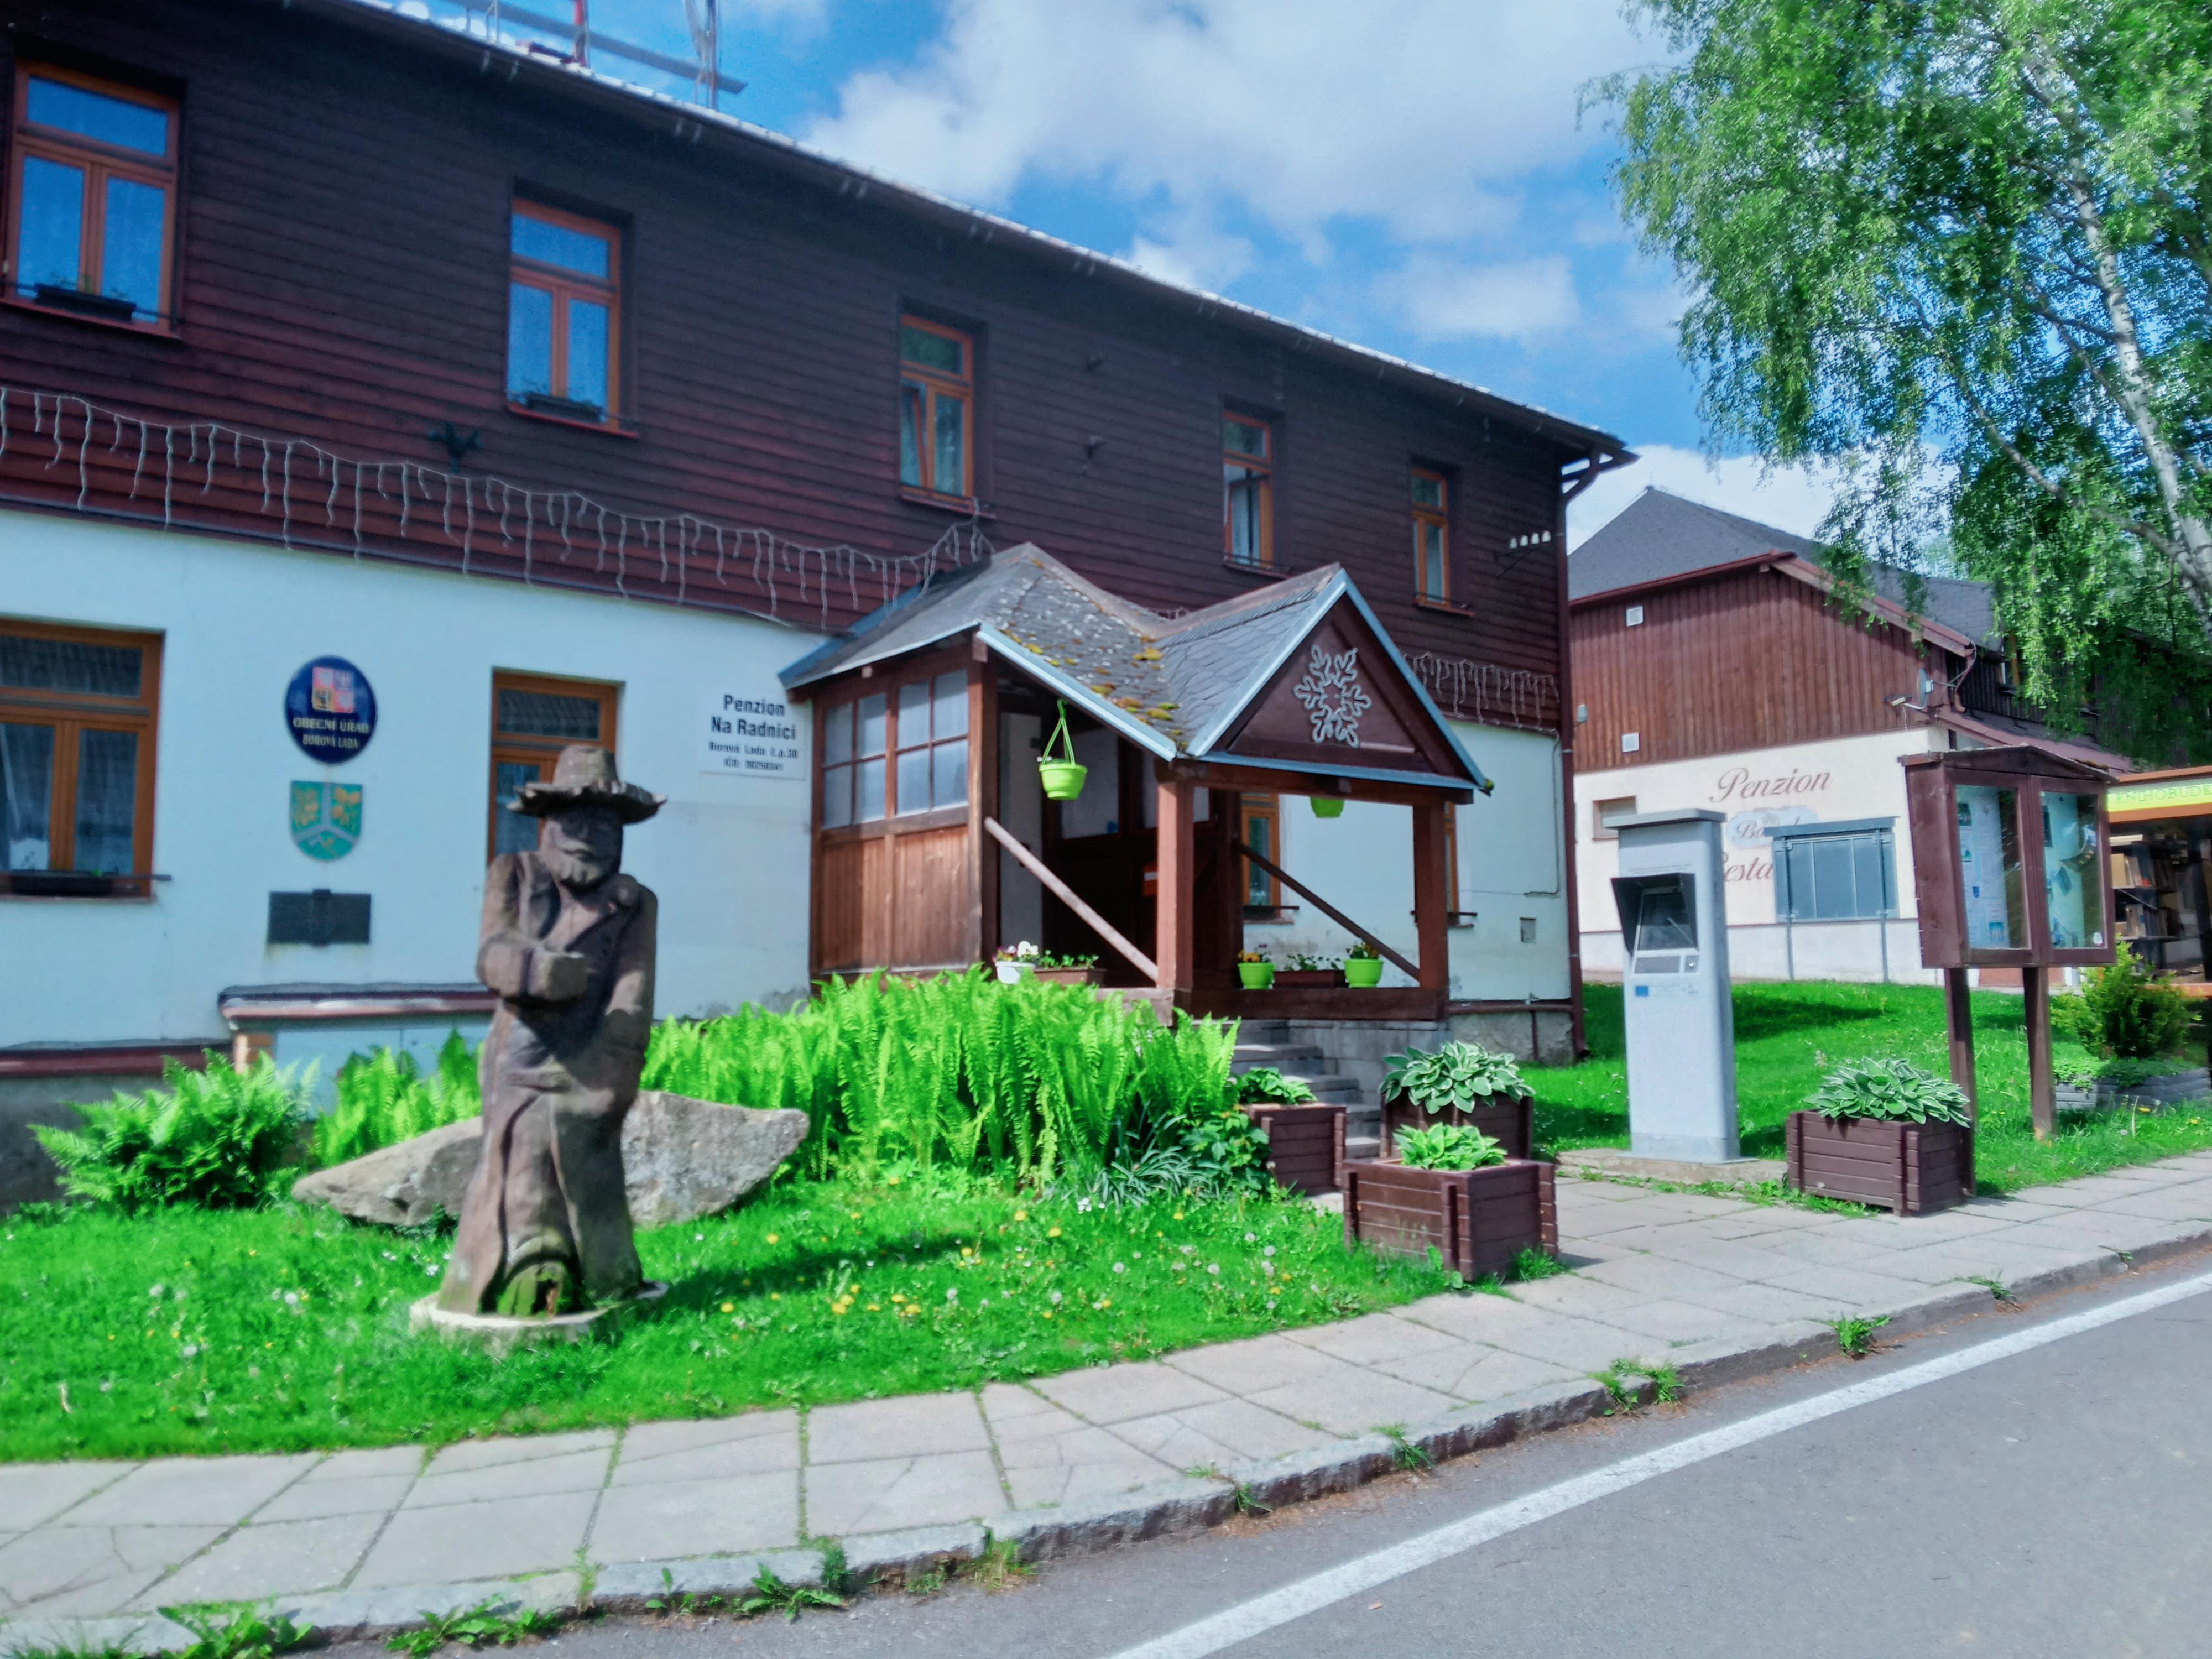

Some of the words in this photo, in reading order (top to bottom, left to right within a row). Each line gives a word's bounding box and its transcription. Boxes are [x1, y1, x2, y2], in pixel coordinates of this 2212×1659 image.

[723, 694, 785, 716] Penzion
[711, 717, 732, 733] Na
[737, 719, 797, 740] Radnici
[1709, 767, 1833, 802] Penzion
